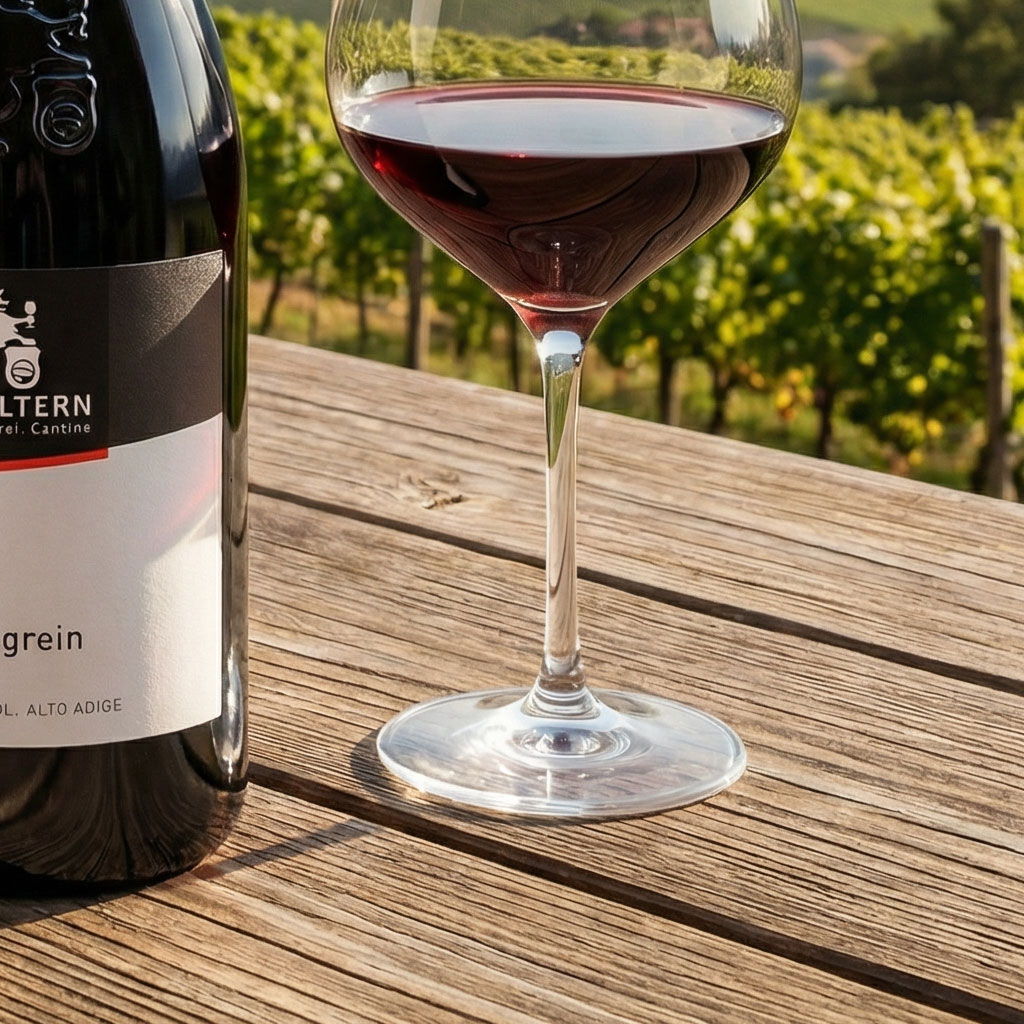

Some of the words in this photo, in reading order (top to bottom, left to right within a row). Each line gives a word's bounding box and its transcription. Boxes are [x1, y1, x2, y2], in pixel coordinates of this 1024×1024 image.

[30, 420, 91, 435] Cantine
[26, 702, 67, 717] ALTO
[73, 697, 123, 715] ADIGE
